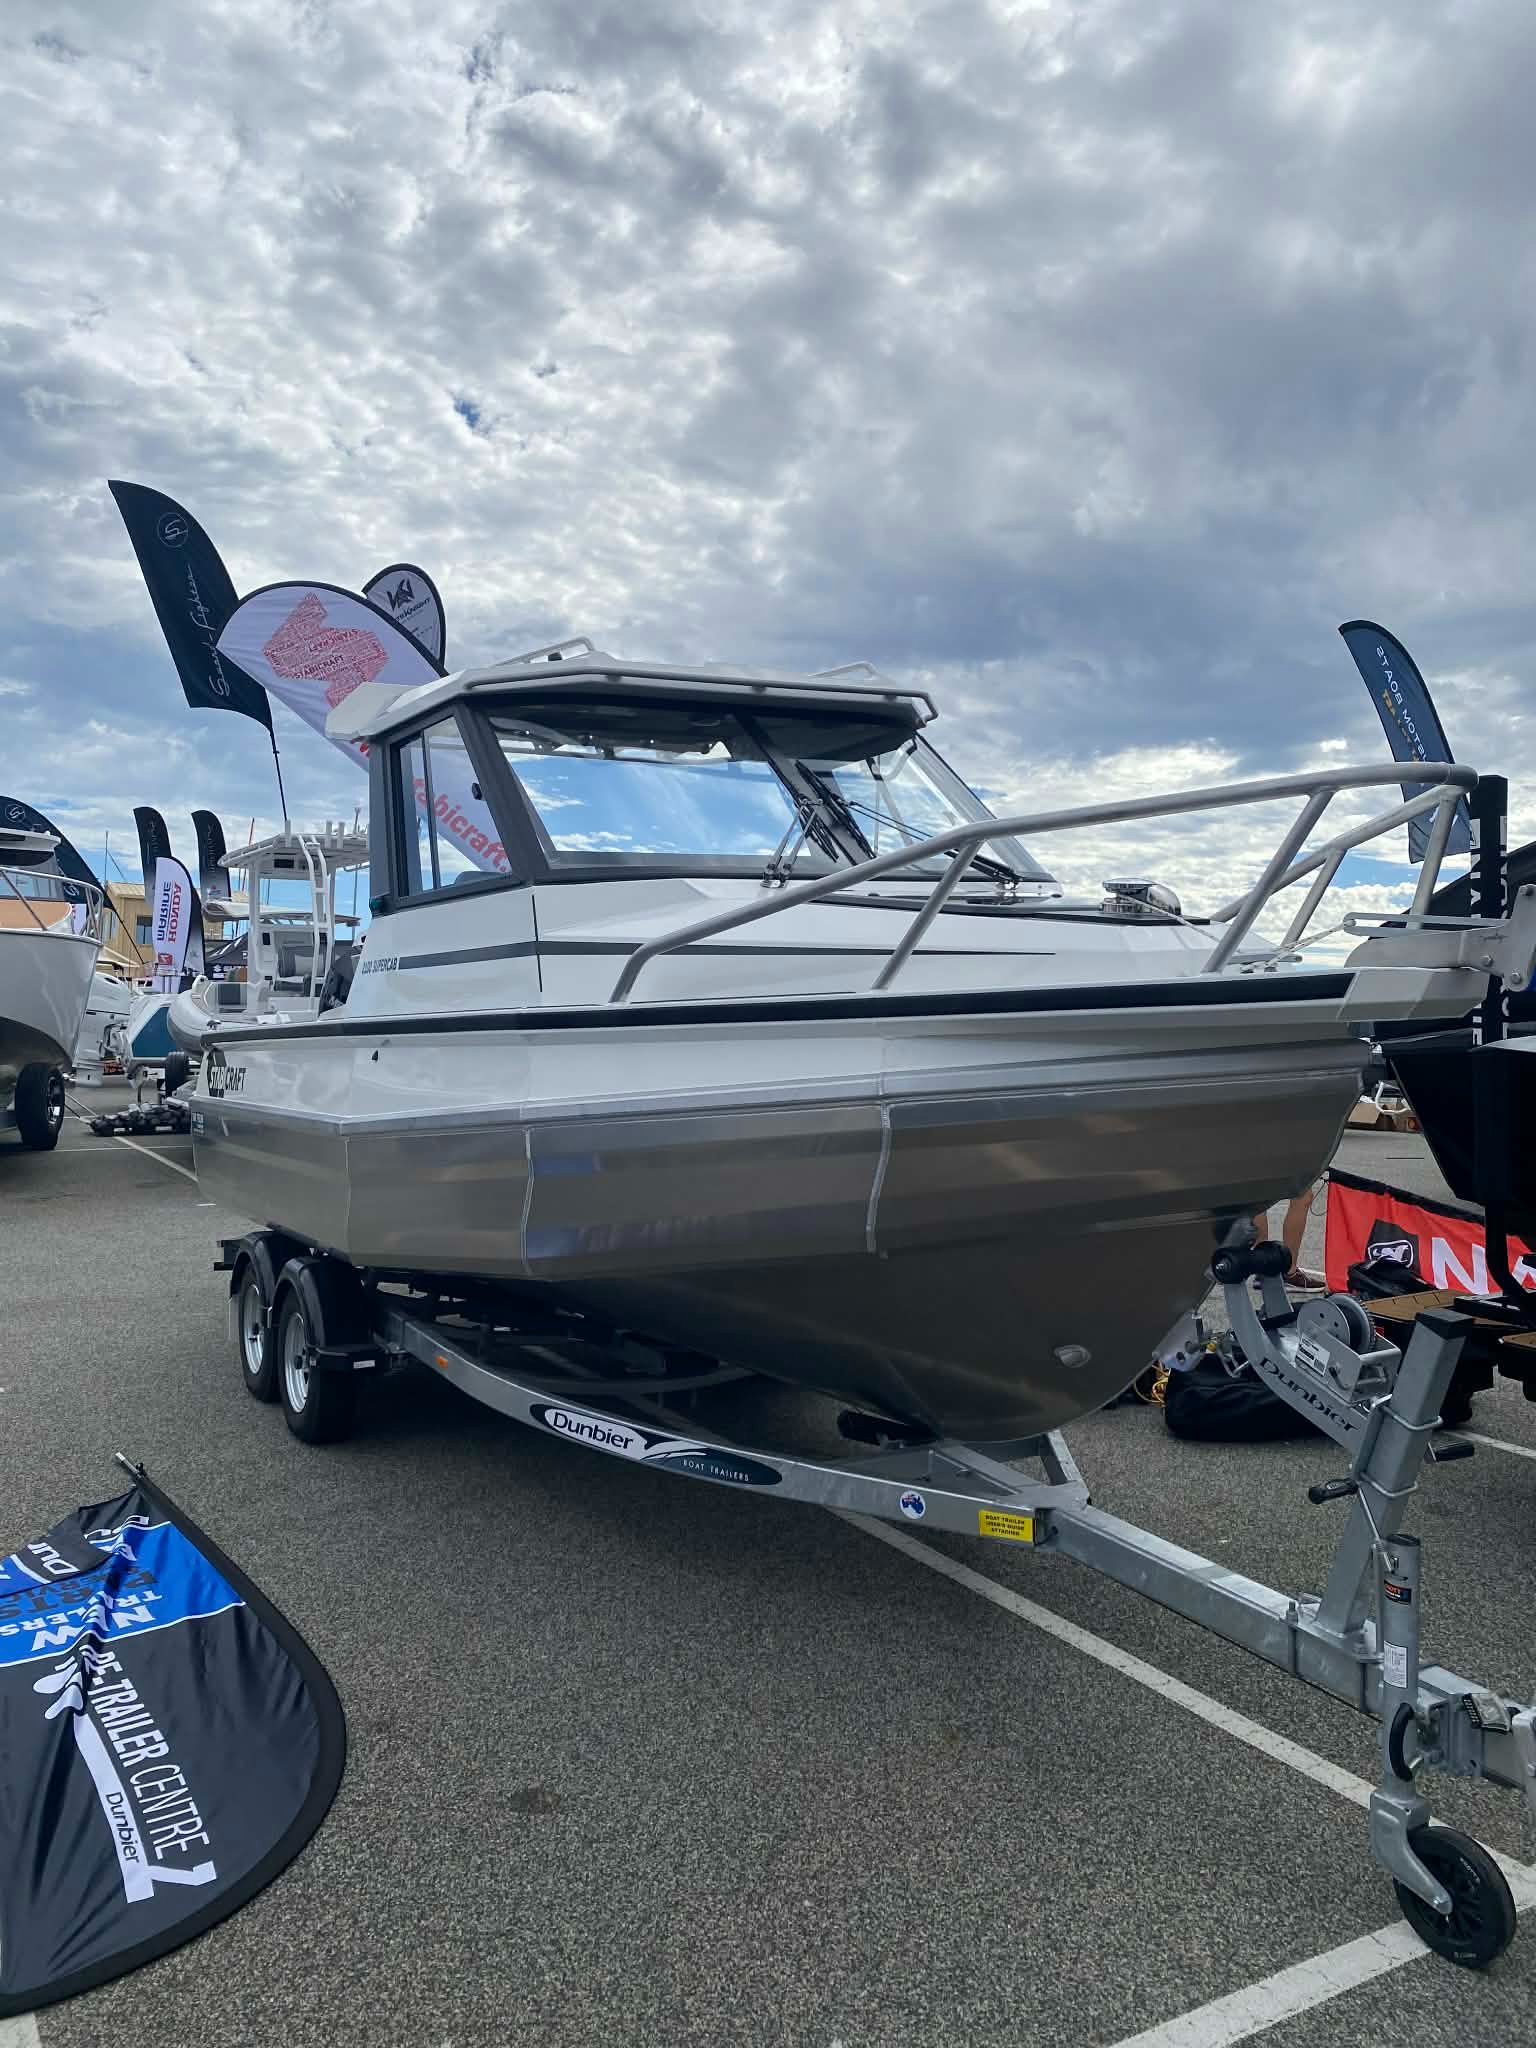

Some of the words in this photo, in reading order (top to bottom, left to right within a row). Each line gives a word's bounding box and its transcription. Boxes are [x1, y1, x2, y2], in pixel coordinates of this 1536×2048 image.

[1260, 1357, 1361, 1431] Dunbier
[553, 1411, 634, 1450] Dunbier
[683, 1459, 705, 1472] BOAT
[710, 1464, 750, 1482] TRAILERS
[0, 1570, 158, 1619] PRTS
[31, 1604, 156, 1651] NEW
[106, 1791, 139, 1863] Dunbier
[129, 1763, 210, 1860] CENTRE
